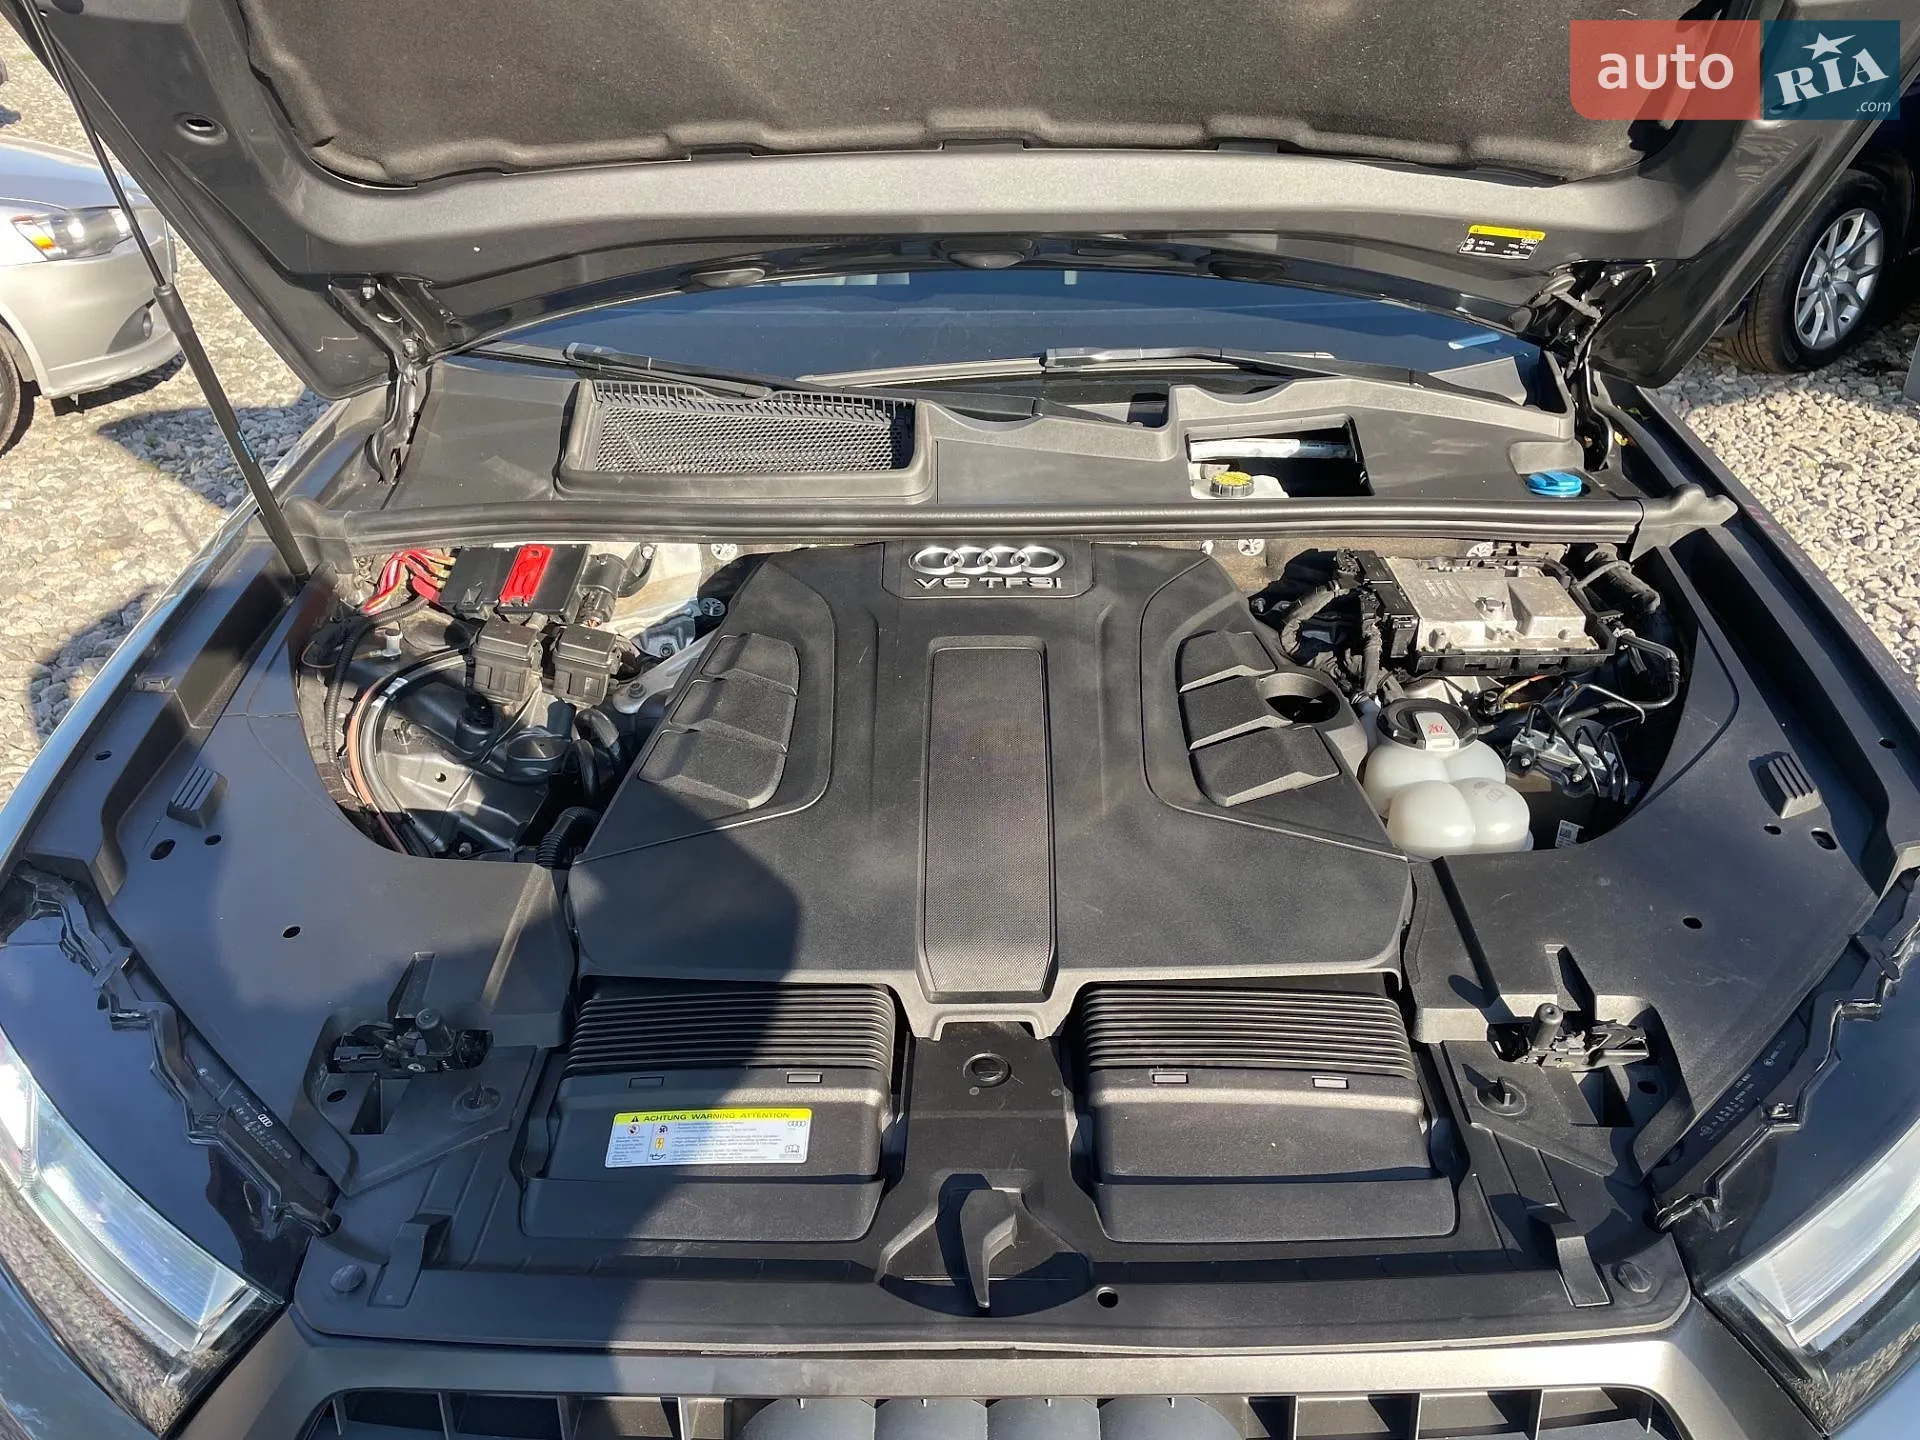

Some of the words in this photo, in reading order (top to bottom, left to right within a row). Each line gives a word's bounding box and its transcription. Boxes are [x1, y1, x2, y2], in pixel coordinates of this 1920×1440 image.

[914, 577, 970, 589] V6
[978, 577, 1062, 589] TFSI
[643, 1114, 687, 1122] ACHTUNG
